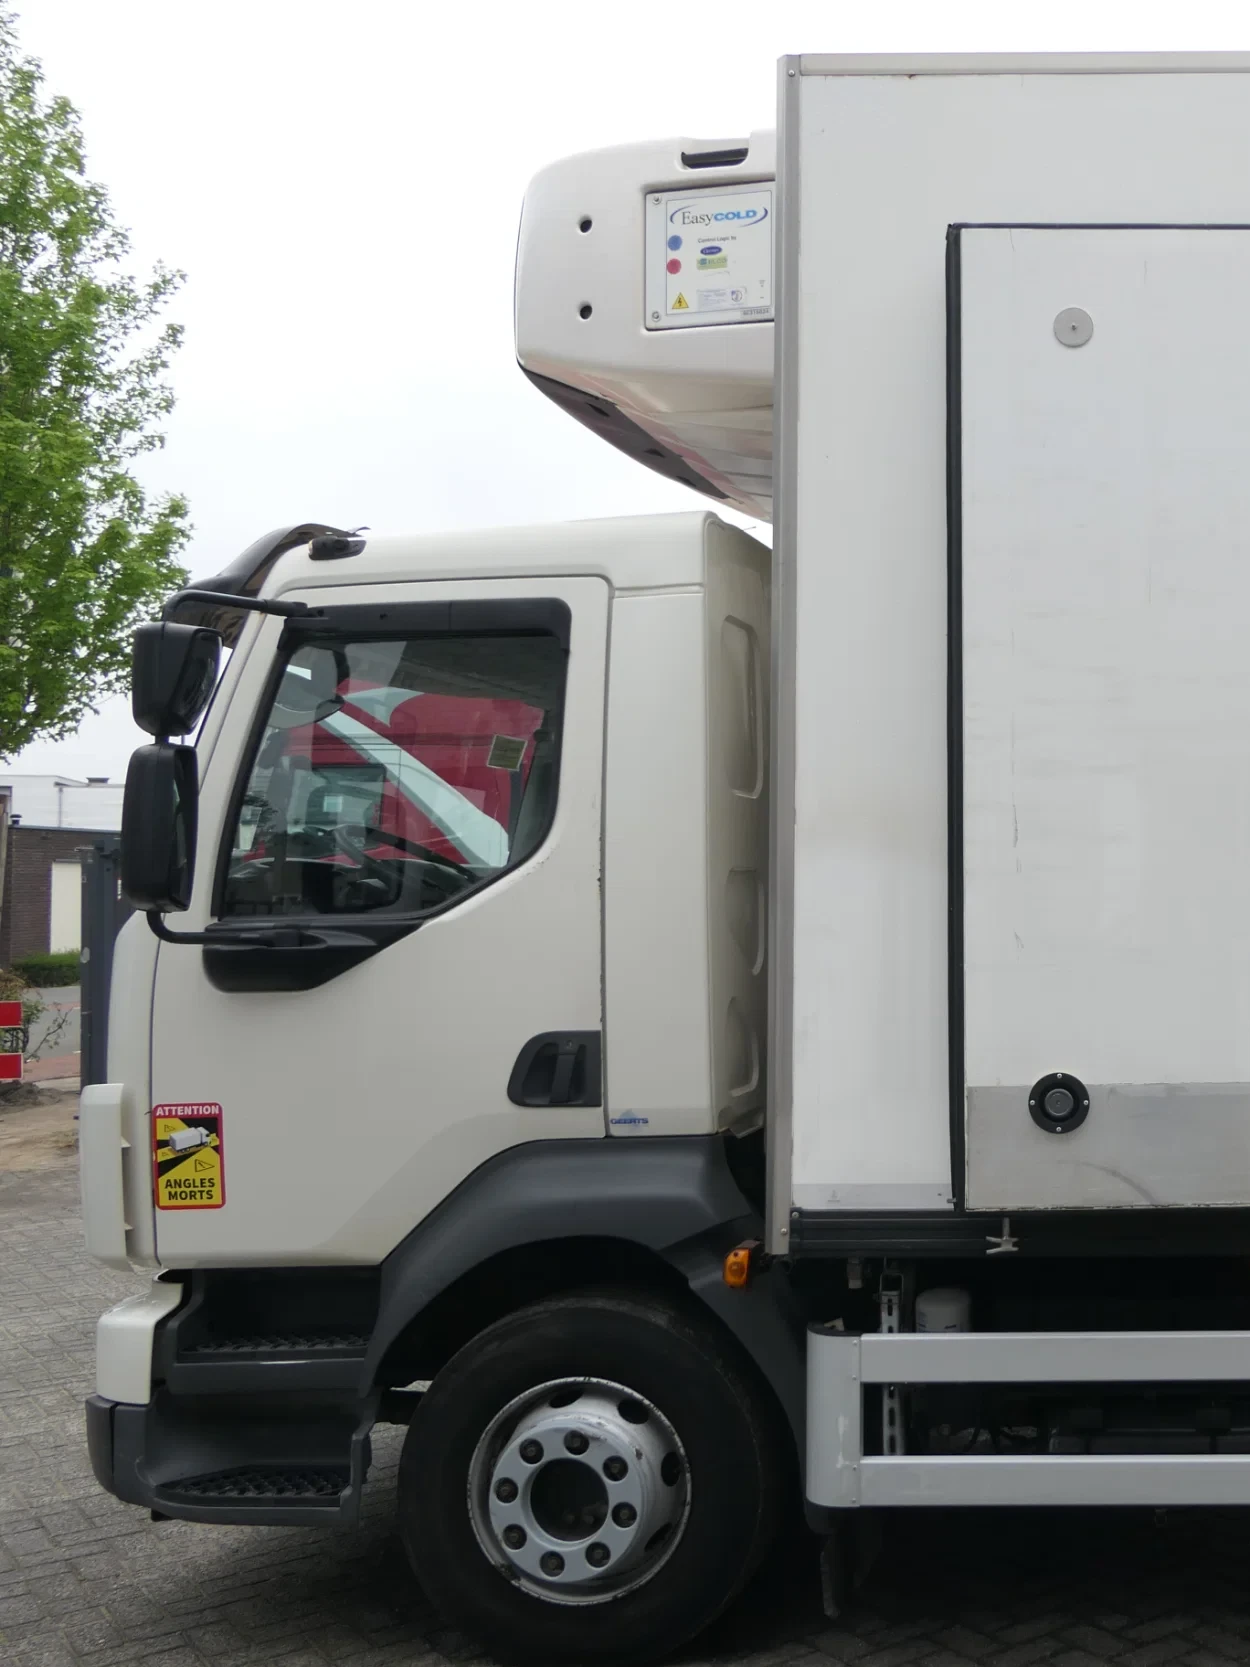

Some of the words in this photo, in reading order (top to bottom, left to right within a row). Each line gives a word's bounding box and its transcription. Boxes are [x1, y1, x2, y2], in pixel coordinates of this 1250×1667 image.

[681, 209, 757, 226] EasyCOLD
[156, 1105, 220, 1116] ATTENTION
[165, 1178, 216, 1189] ANGLES
[168, 1190, 214, 1201] MORTS
